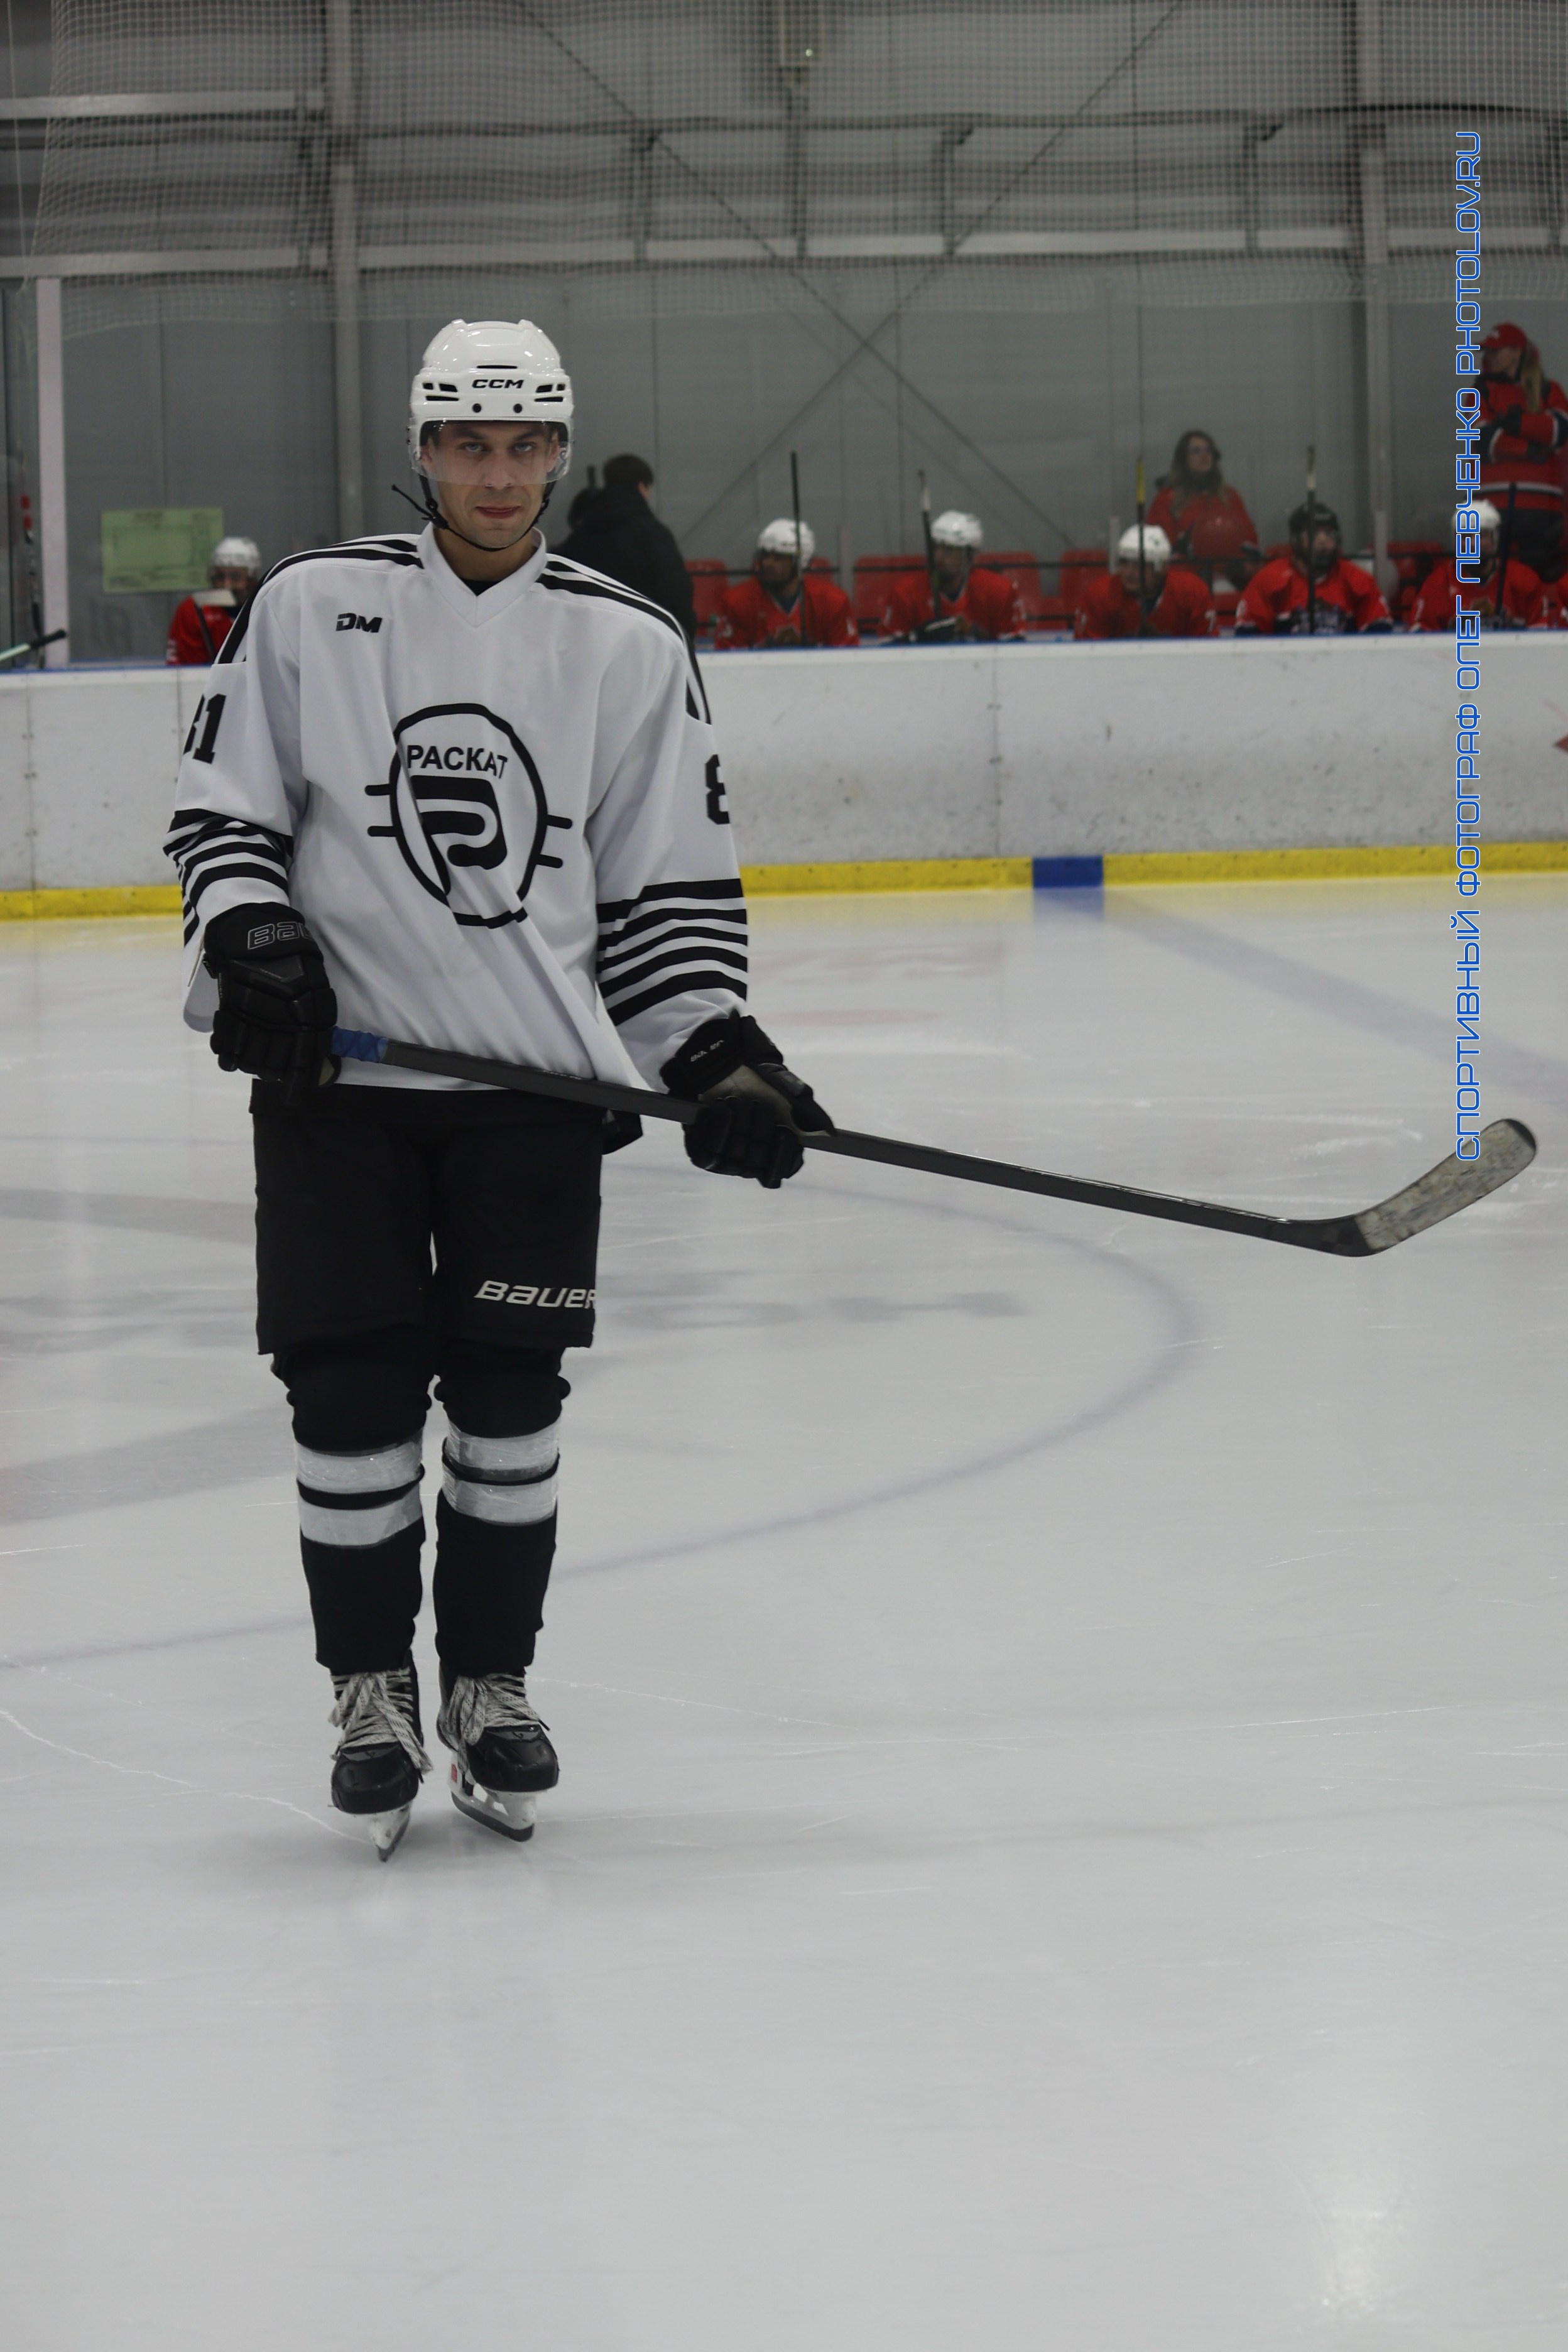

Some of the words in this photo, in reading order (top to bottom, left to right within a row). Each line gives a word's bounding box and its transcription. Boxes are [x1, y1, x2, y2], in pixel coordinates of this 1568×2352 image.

[472, 379, 525, 389] CCM
[335, 612, 383, 633] DM
[406, 744, 508, 779] РАСКАТ
